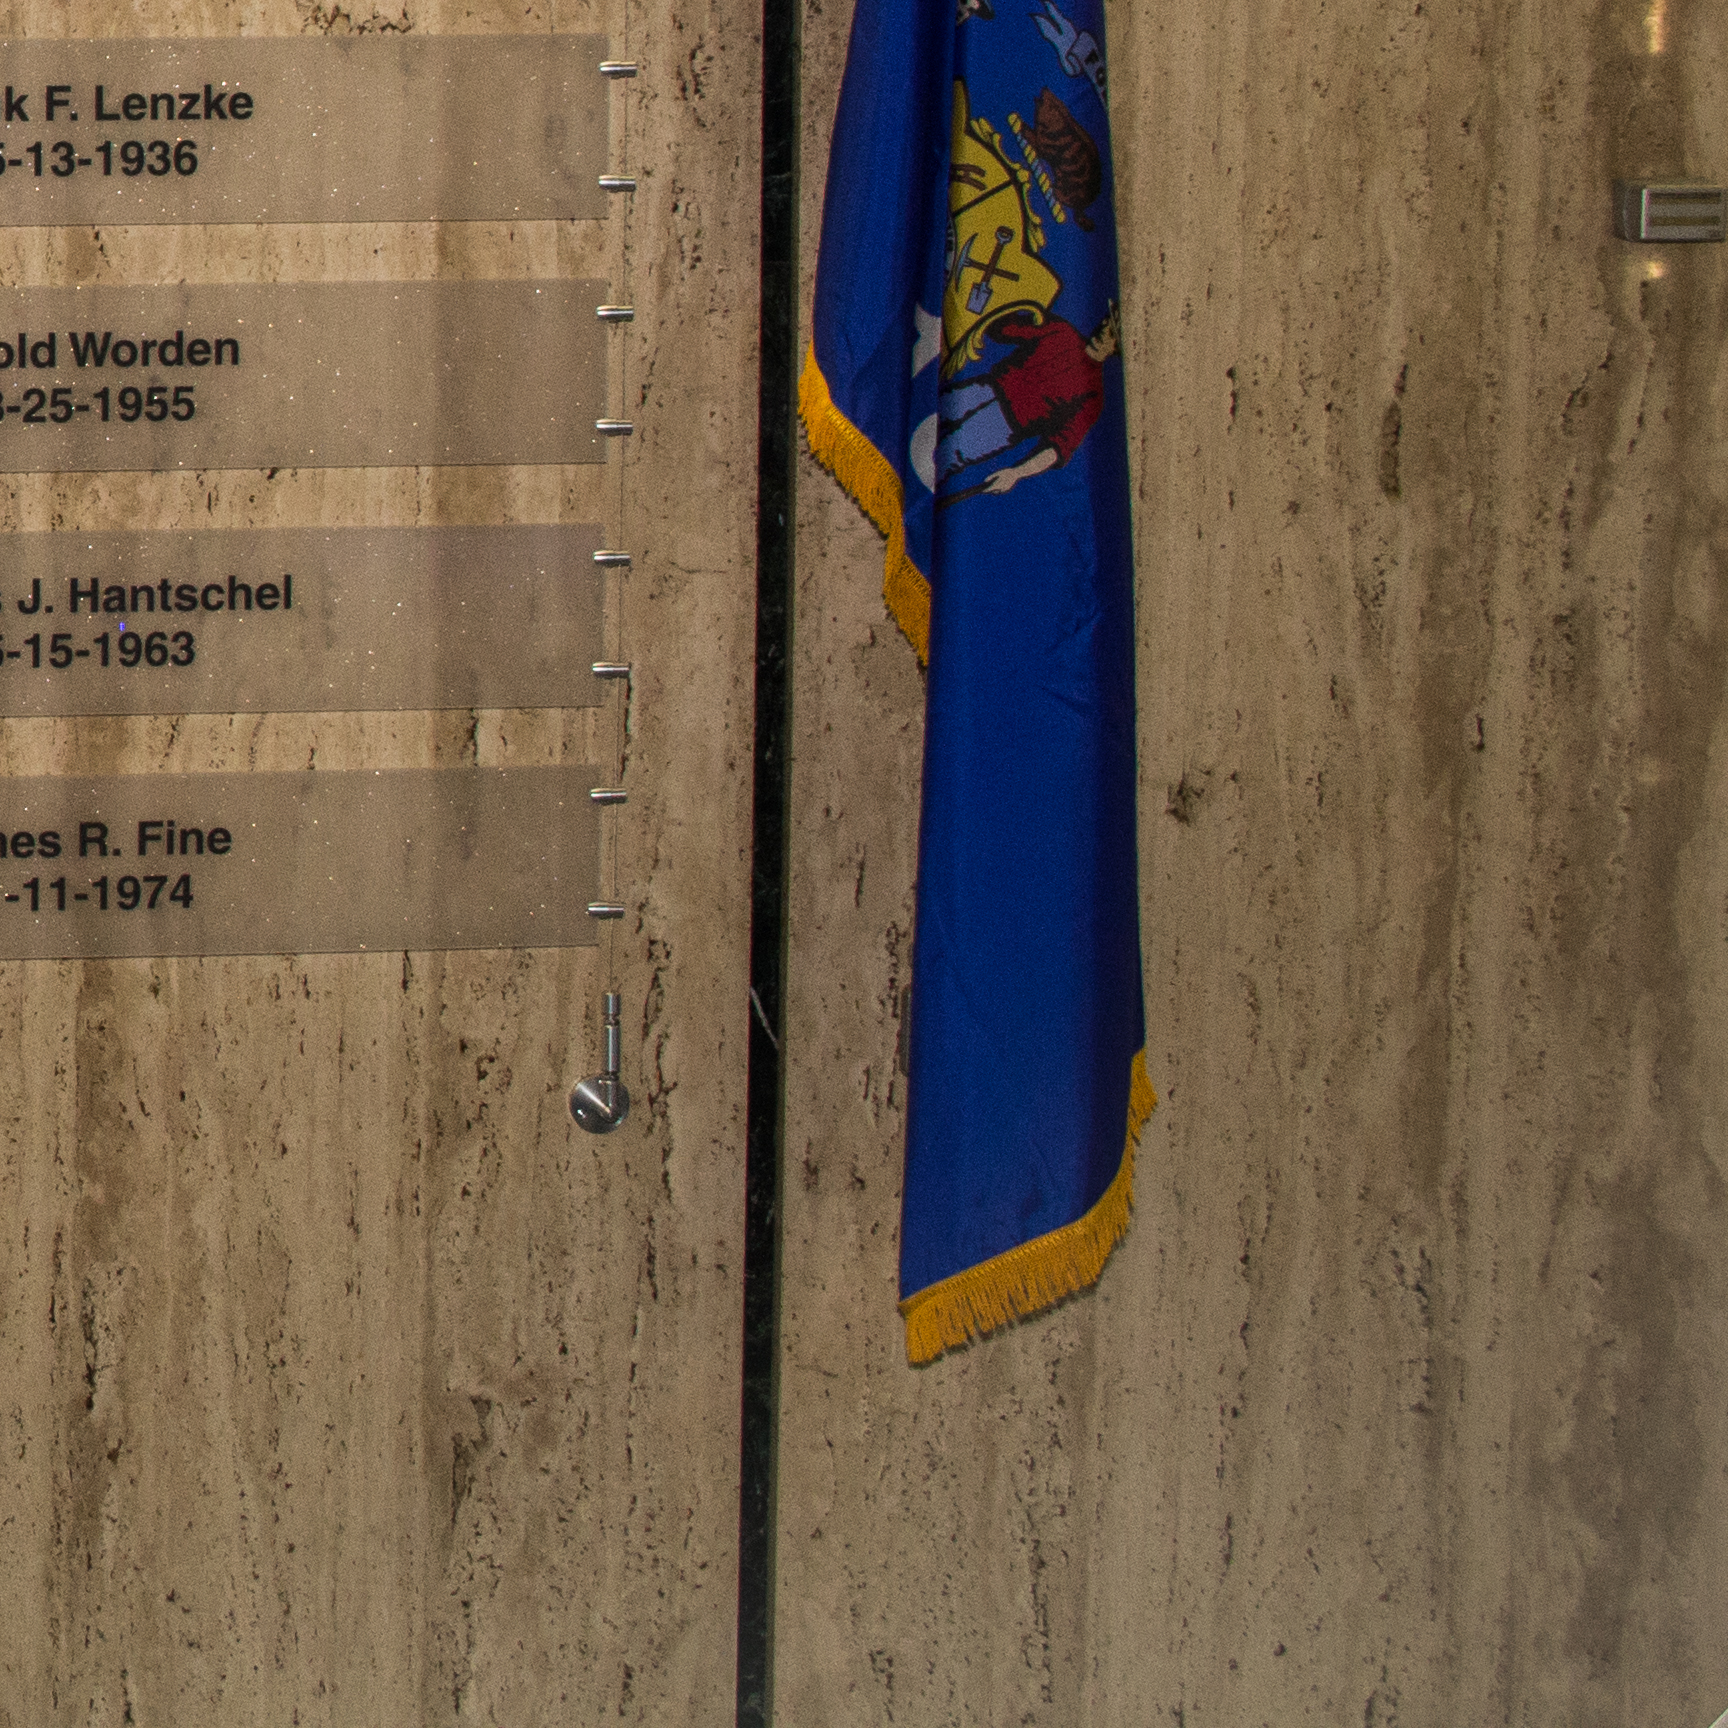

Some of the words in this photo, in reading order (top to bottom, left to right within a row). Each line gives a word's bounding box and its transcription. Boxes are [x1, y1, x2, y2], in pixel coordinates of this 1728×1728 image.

[46, 86, 77, 121] F.
[95, 85, 253, 121] Lenzke
[70, 331, 239, 368] Worden
[17, 579, 53, 615] J.
[70, 576, 291, 614] Hantschel
[78, 822, 120, 857] R.
[138, 821, 231, 855] Fine
